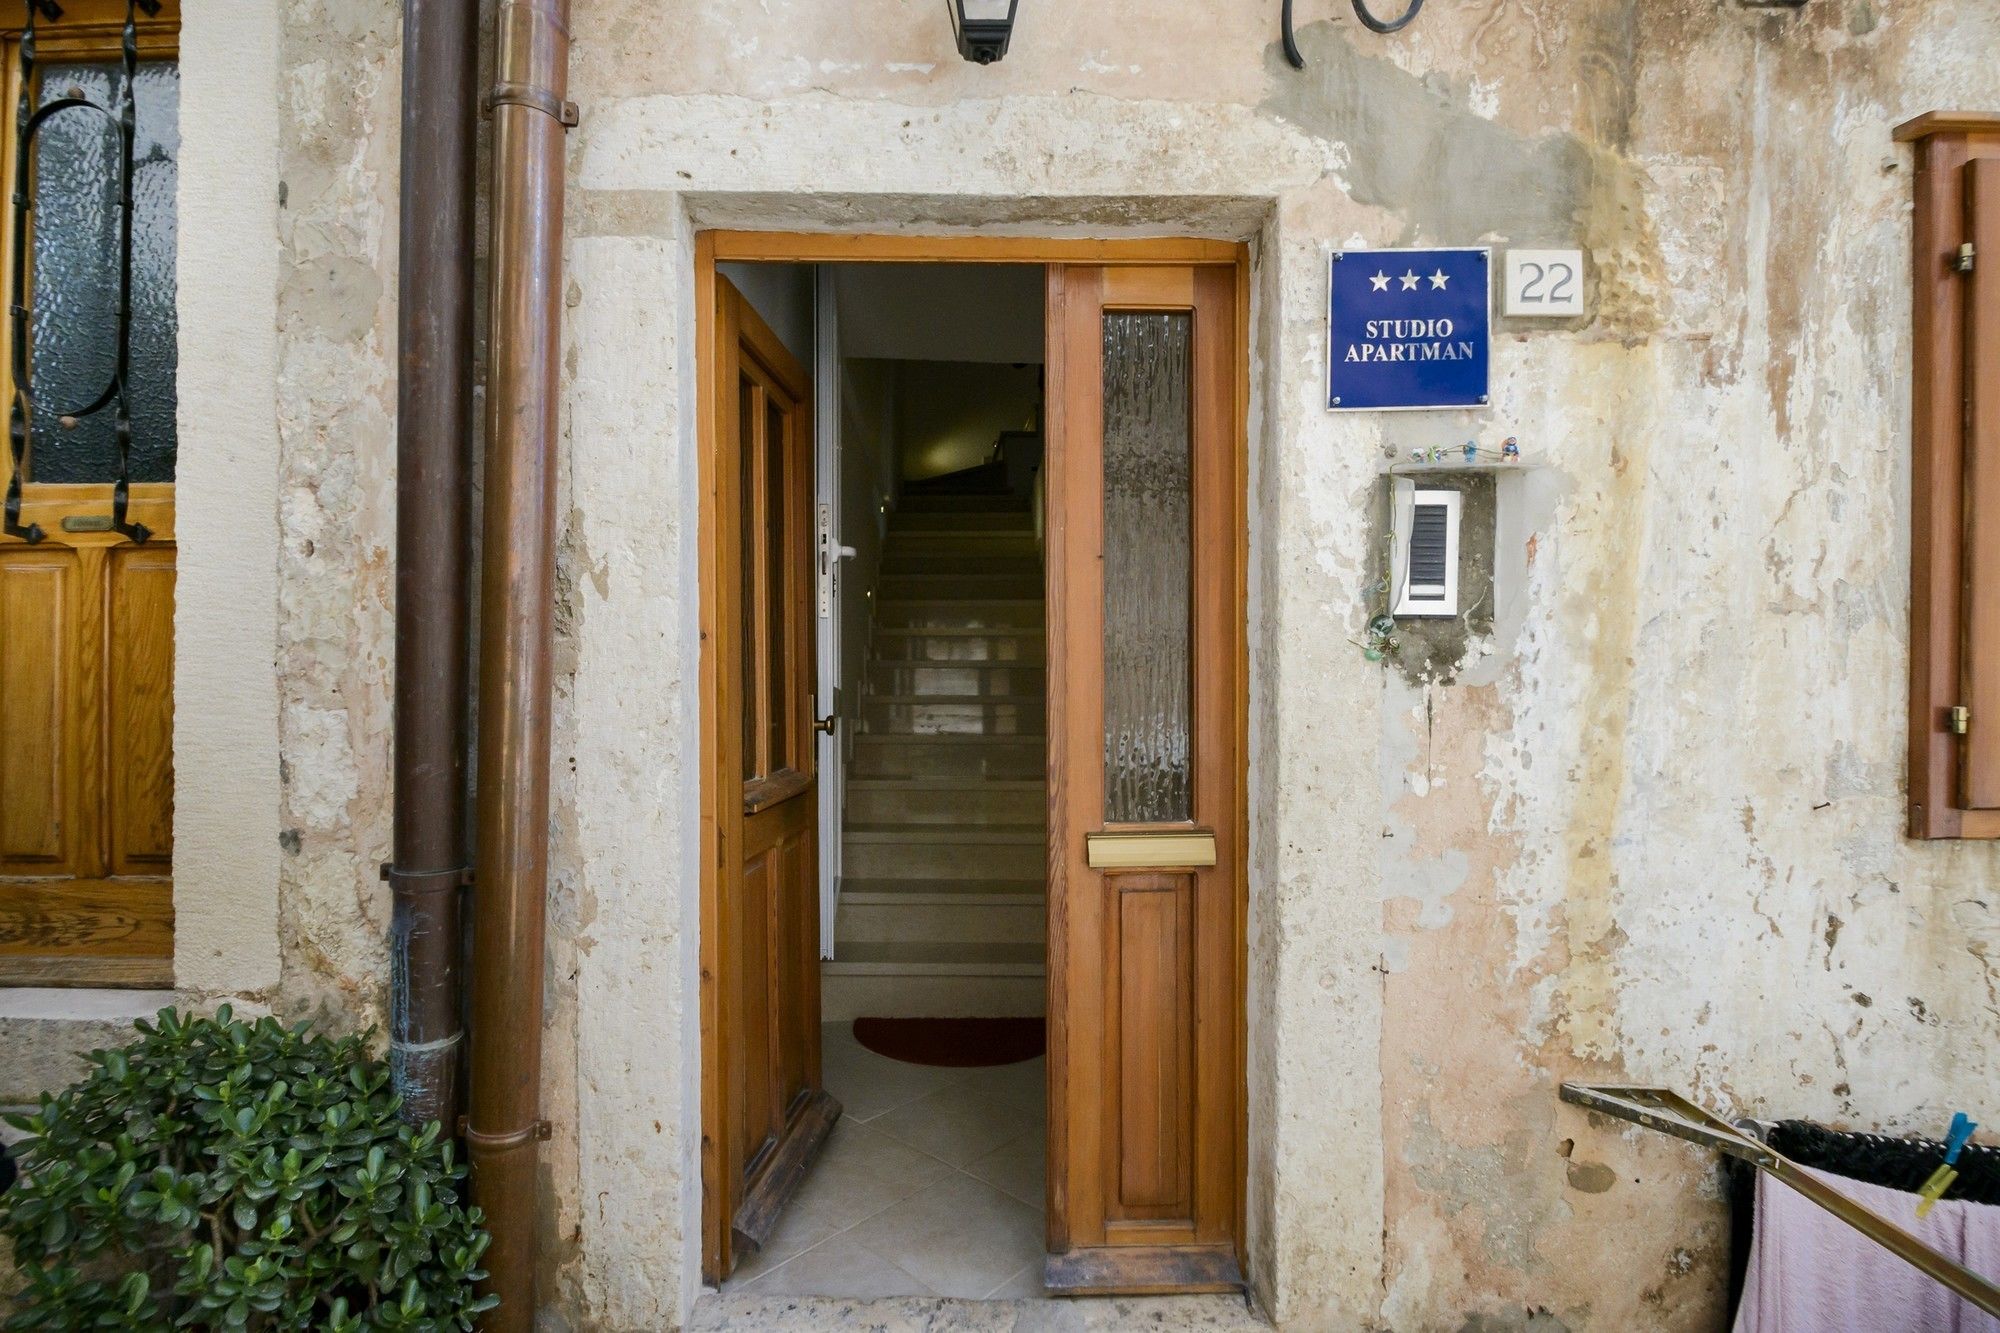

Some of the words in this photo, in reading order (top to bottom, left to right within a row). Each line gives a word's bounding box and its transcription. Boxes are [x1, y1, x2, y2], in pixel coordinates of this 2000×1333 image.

[1519, 262, 1574, 304] 22
[1365, 318, 1454, 339] STUDIO
[1344, 341, 1474, 363] APARTMAN
